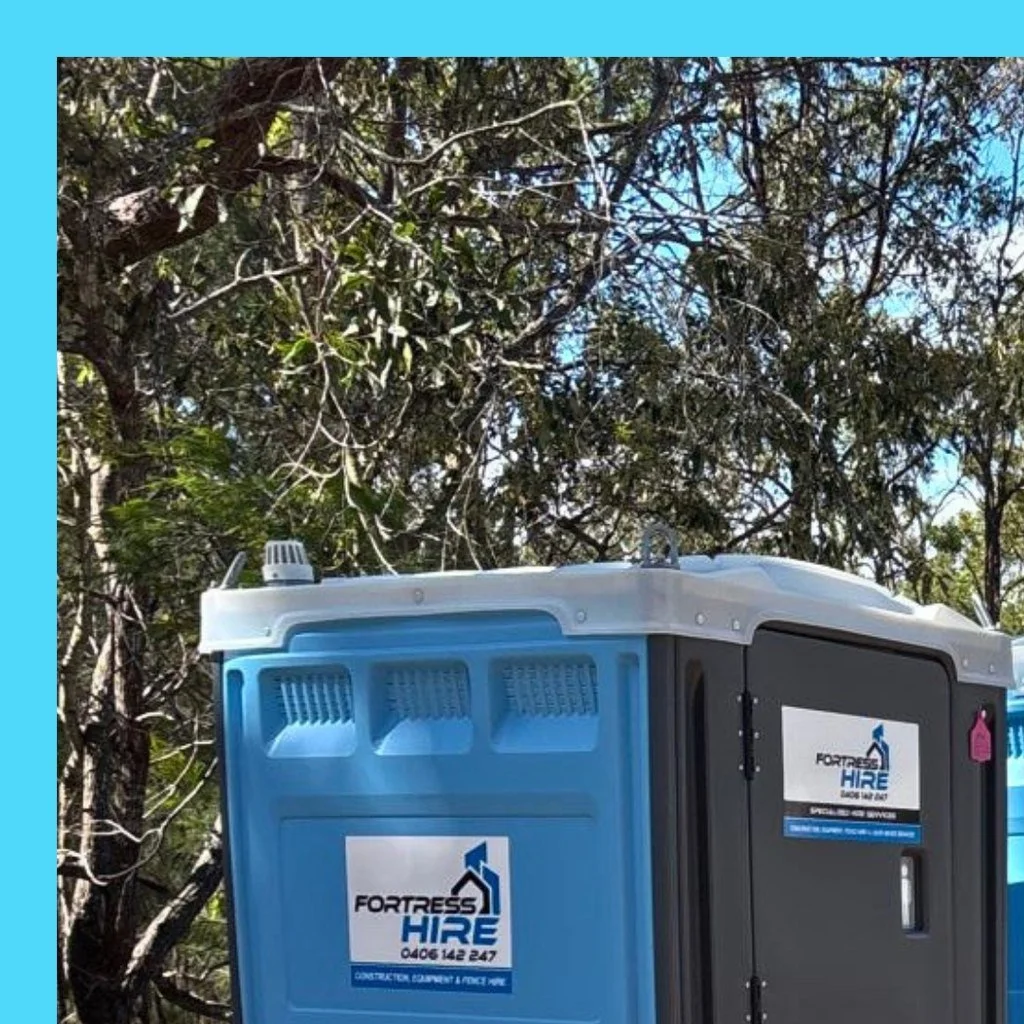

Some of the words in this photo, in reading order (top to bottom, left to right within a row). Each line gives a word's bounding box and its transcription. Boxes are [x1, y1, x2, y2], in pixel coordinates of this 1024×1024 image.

[815, 752, 880, 770] FORTRESS
[840, 769, 889, 791] HIRE
[354, 895, 478, 915] FORTRESS
[401, 915, 500, 946] HIRE
[400, 947, 439, 961] 0406
[441, 948, 465, 961] 142
[468, 949, 498, 962] 247
